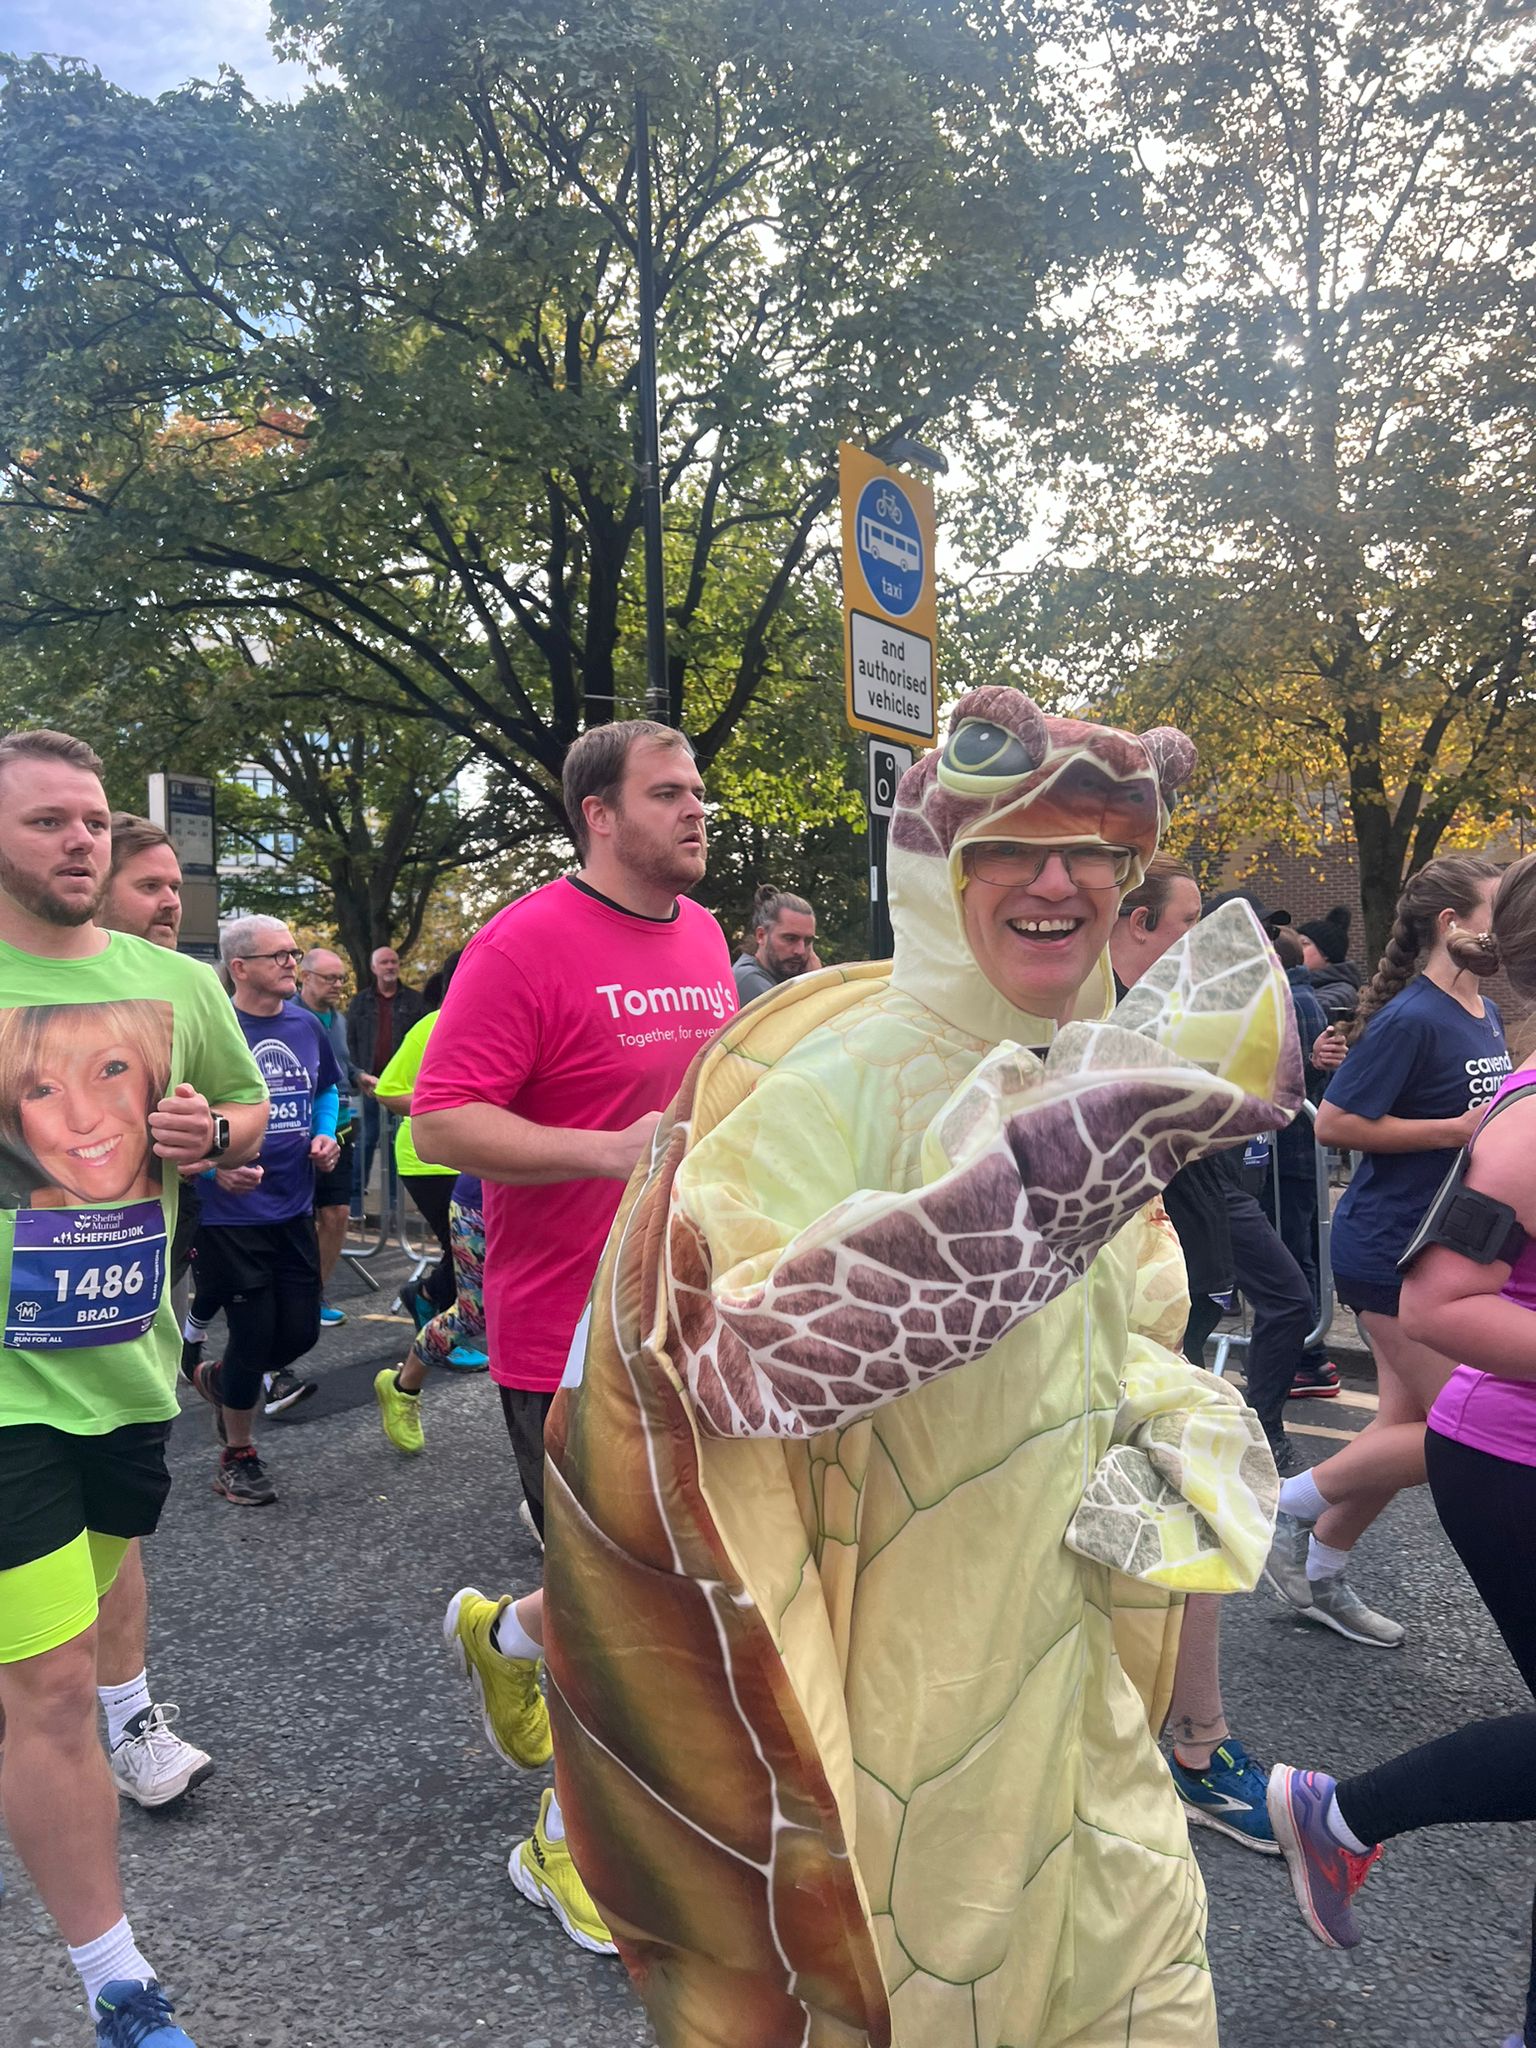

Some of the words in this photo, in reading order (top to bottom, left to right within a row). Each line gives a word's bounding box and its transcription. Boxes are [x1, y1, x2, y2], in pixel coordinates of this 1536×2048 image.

[882, 576, 902, 600] taxi
[882, 639, 905, 661] and
[859, 659, 927, 695] authorised
[868, 689, 920, 720] vehicles
[596, 981, 735, 1019] Tommy's
[617, 1027, 677, 1047] Together,
[679, 1025, 692, 1039] for
[92, 1212, 124, 1222] Sheffield
[92, 1221, 120, 1230] Mutual
[54, 1261, 144, 1302] 1486
[77, 1307, 119, 1322] BRAD
